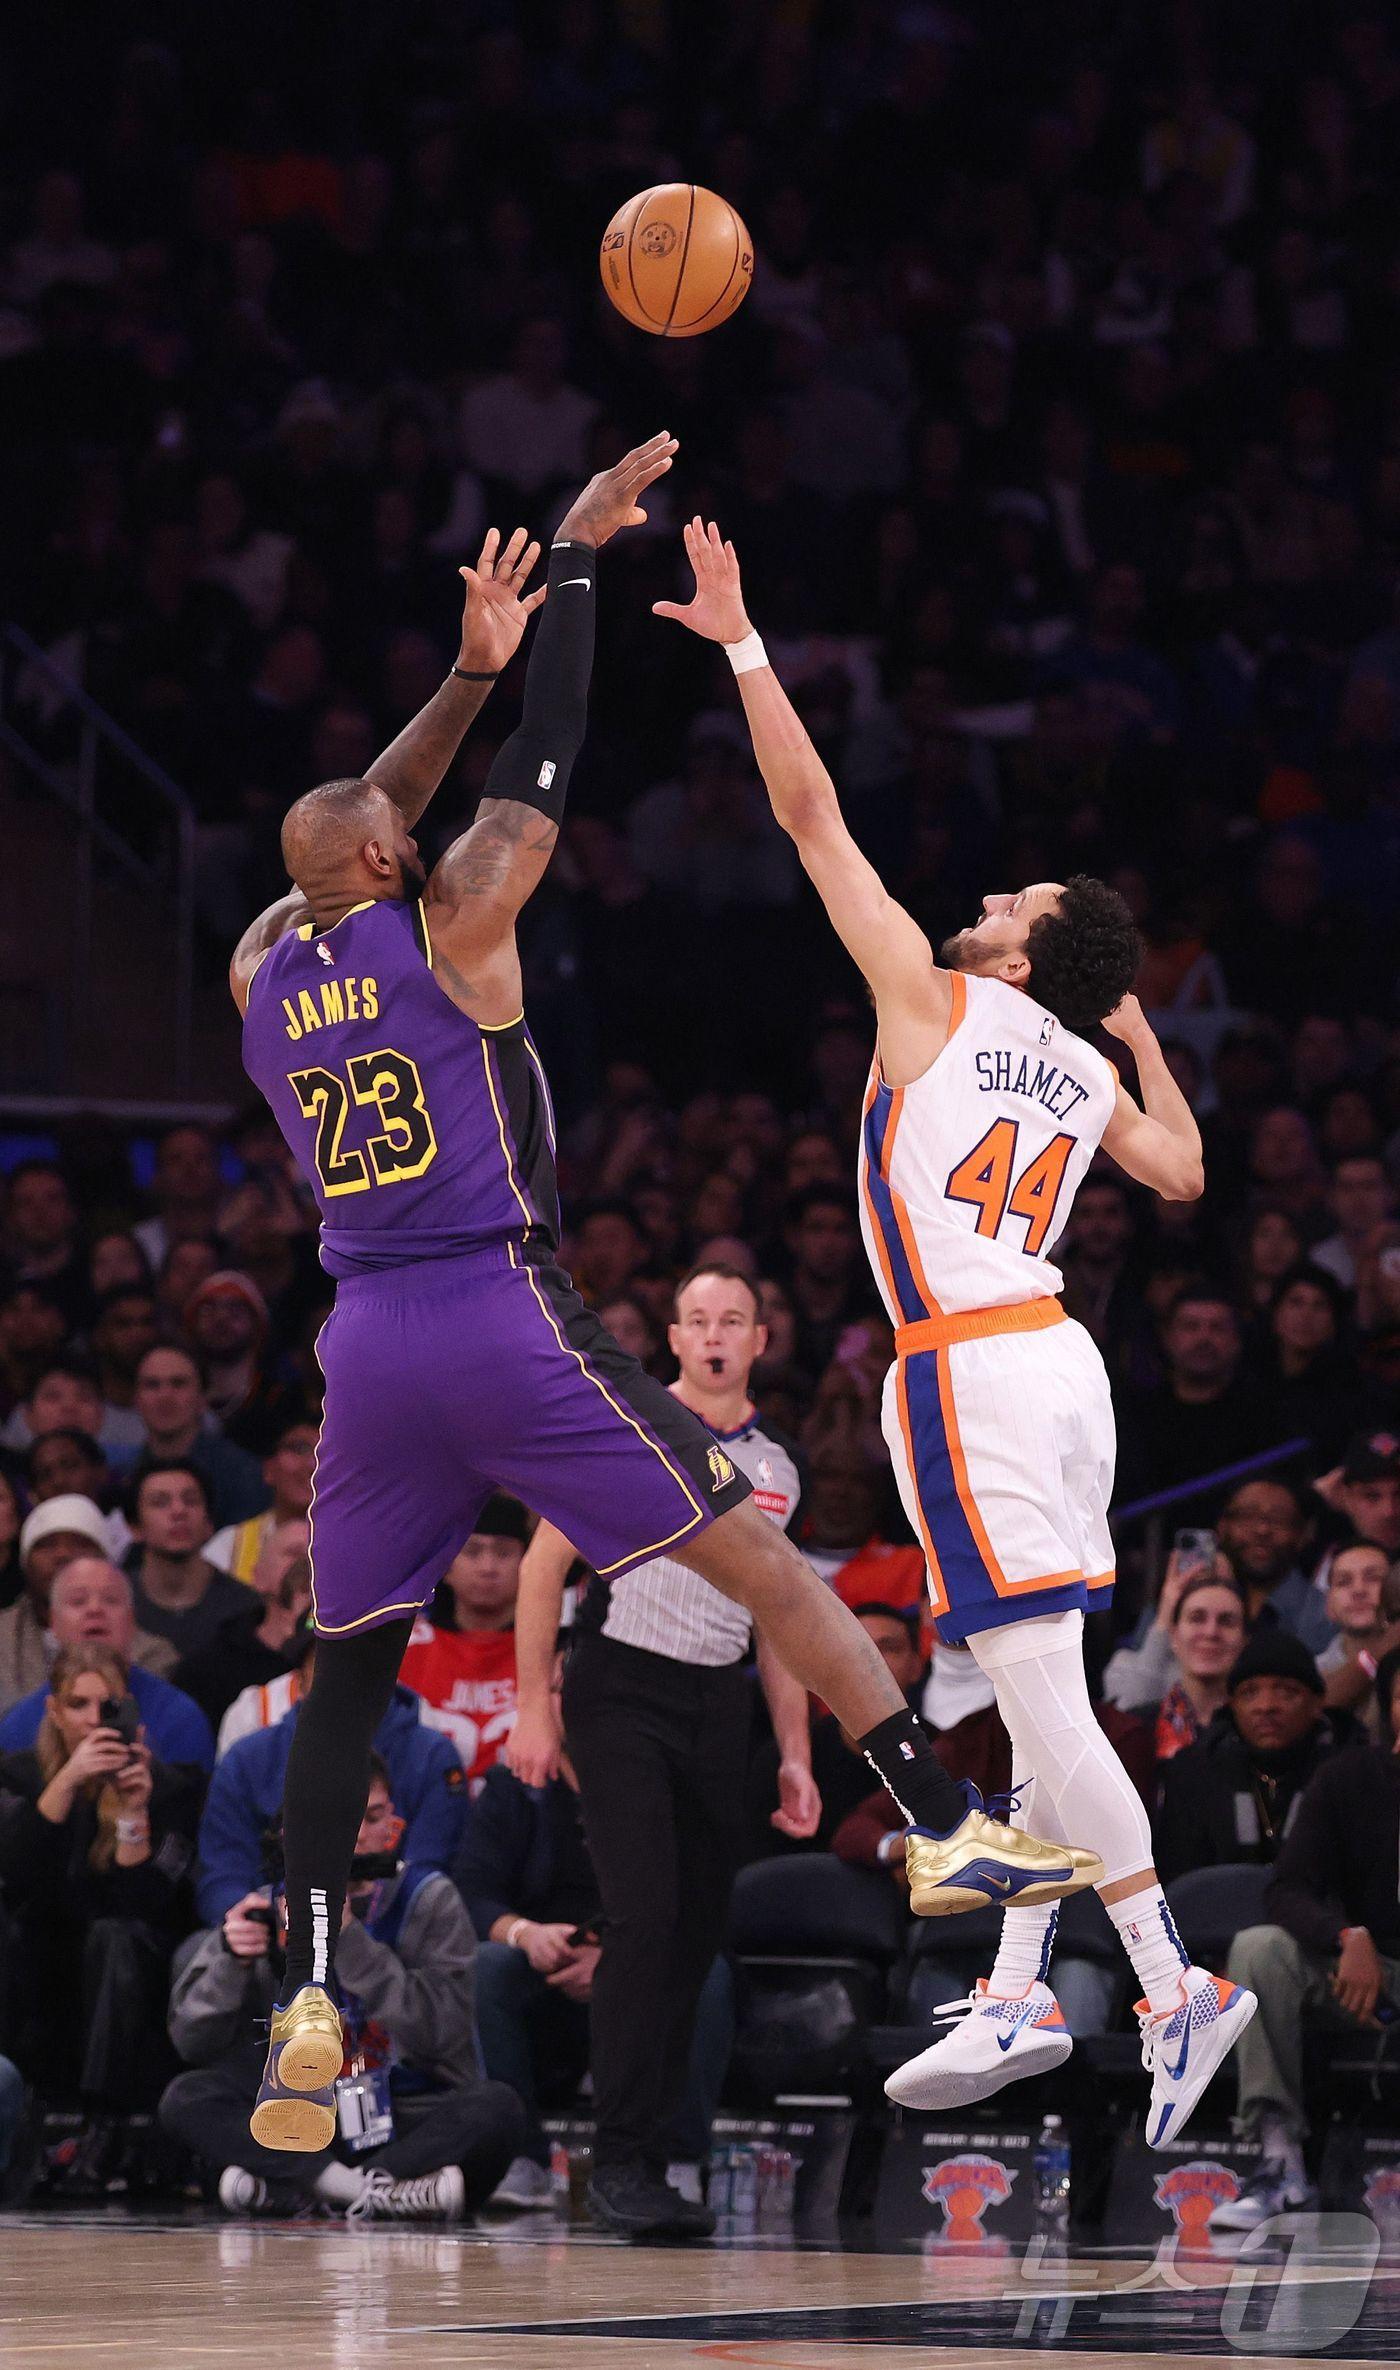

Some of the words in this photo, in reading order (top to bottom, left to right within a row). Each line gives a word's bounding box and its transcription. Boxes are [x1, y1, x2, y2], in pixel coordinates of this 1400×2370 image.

[281, 976, 379, 1041] JAMES
[286, 1047, 438, 1198] 23
[975, 1050, 1090, 1121] SHAMET
[943, 1116, 1078, 1257] 44
